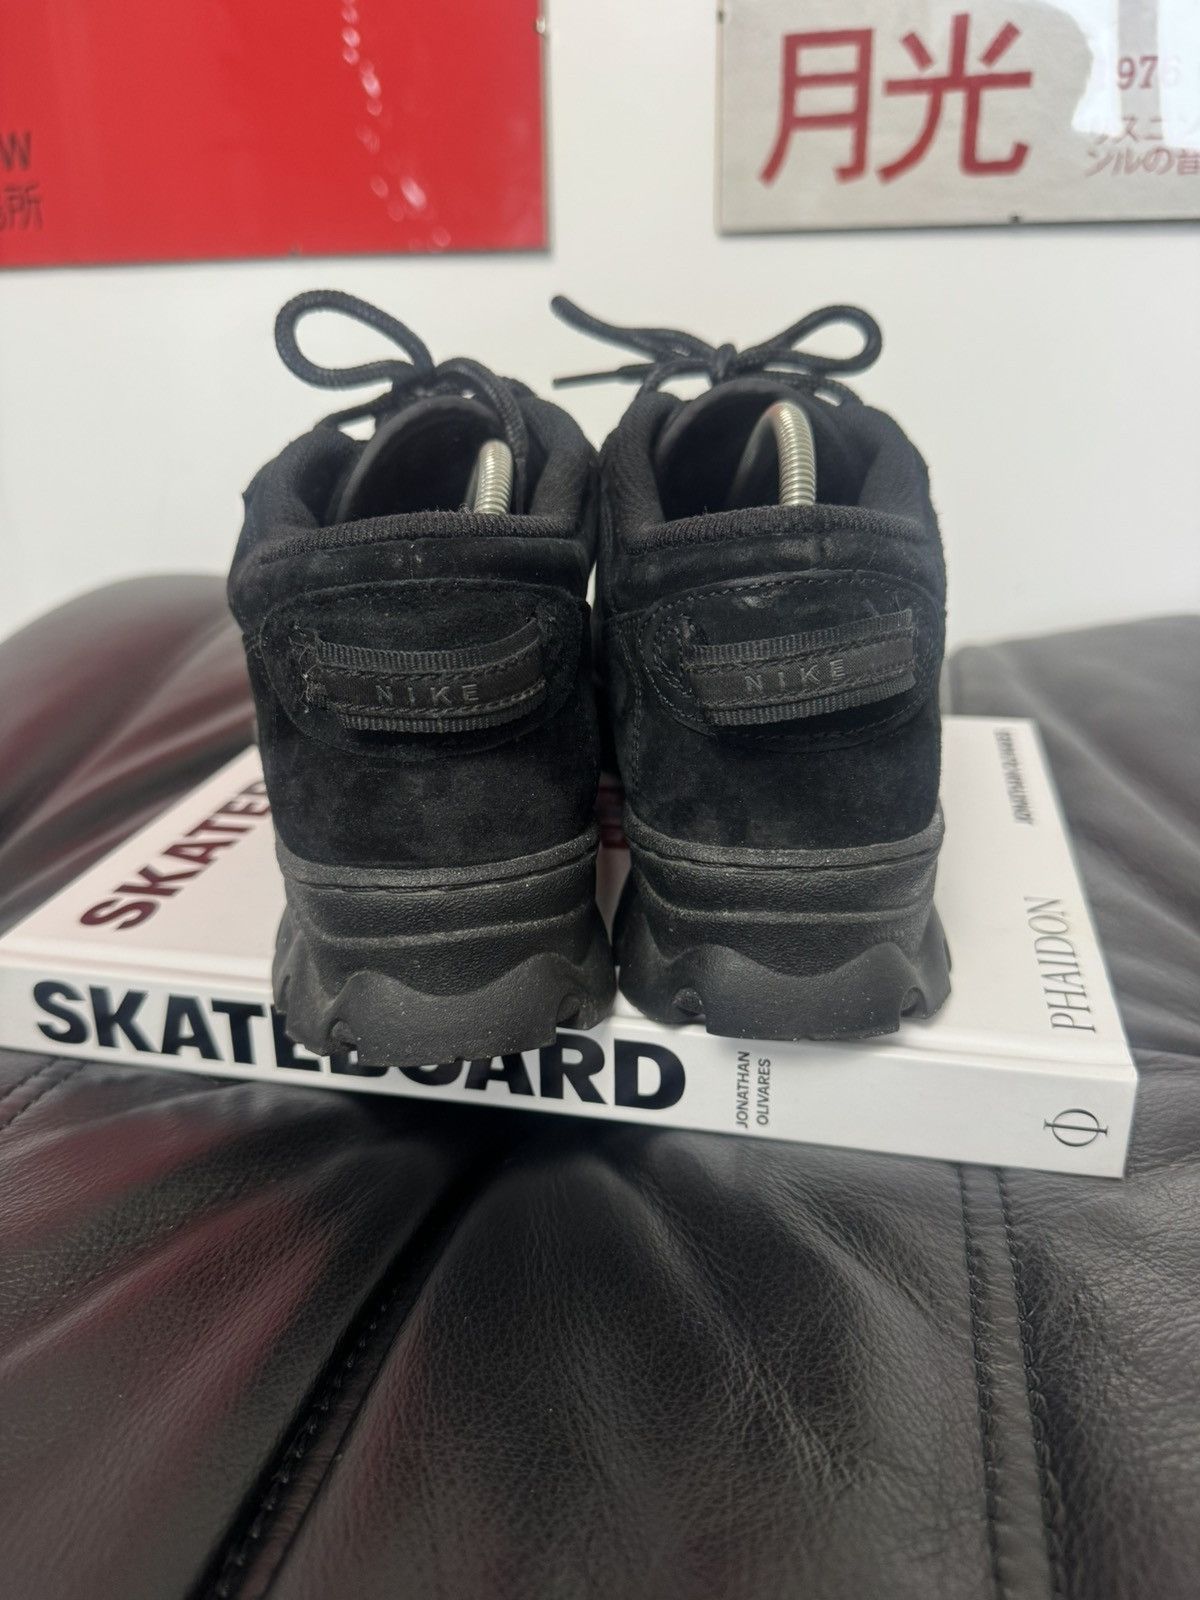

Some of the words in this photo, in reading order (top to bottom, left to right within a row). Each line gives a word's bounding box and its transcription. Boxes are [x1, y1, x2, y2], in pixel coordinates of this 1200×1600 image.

[758, 13, 1033, 189] 月光
[375, 683, 480, 704] NIKE
[745, 658, 845, 691] NIKE
[1024, 896, 1097, 1033] PHAIDON
[736, 1051, 750, 1128] JONATHAN
[756, 1058, 771, 1125] OLIVARES
